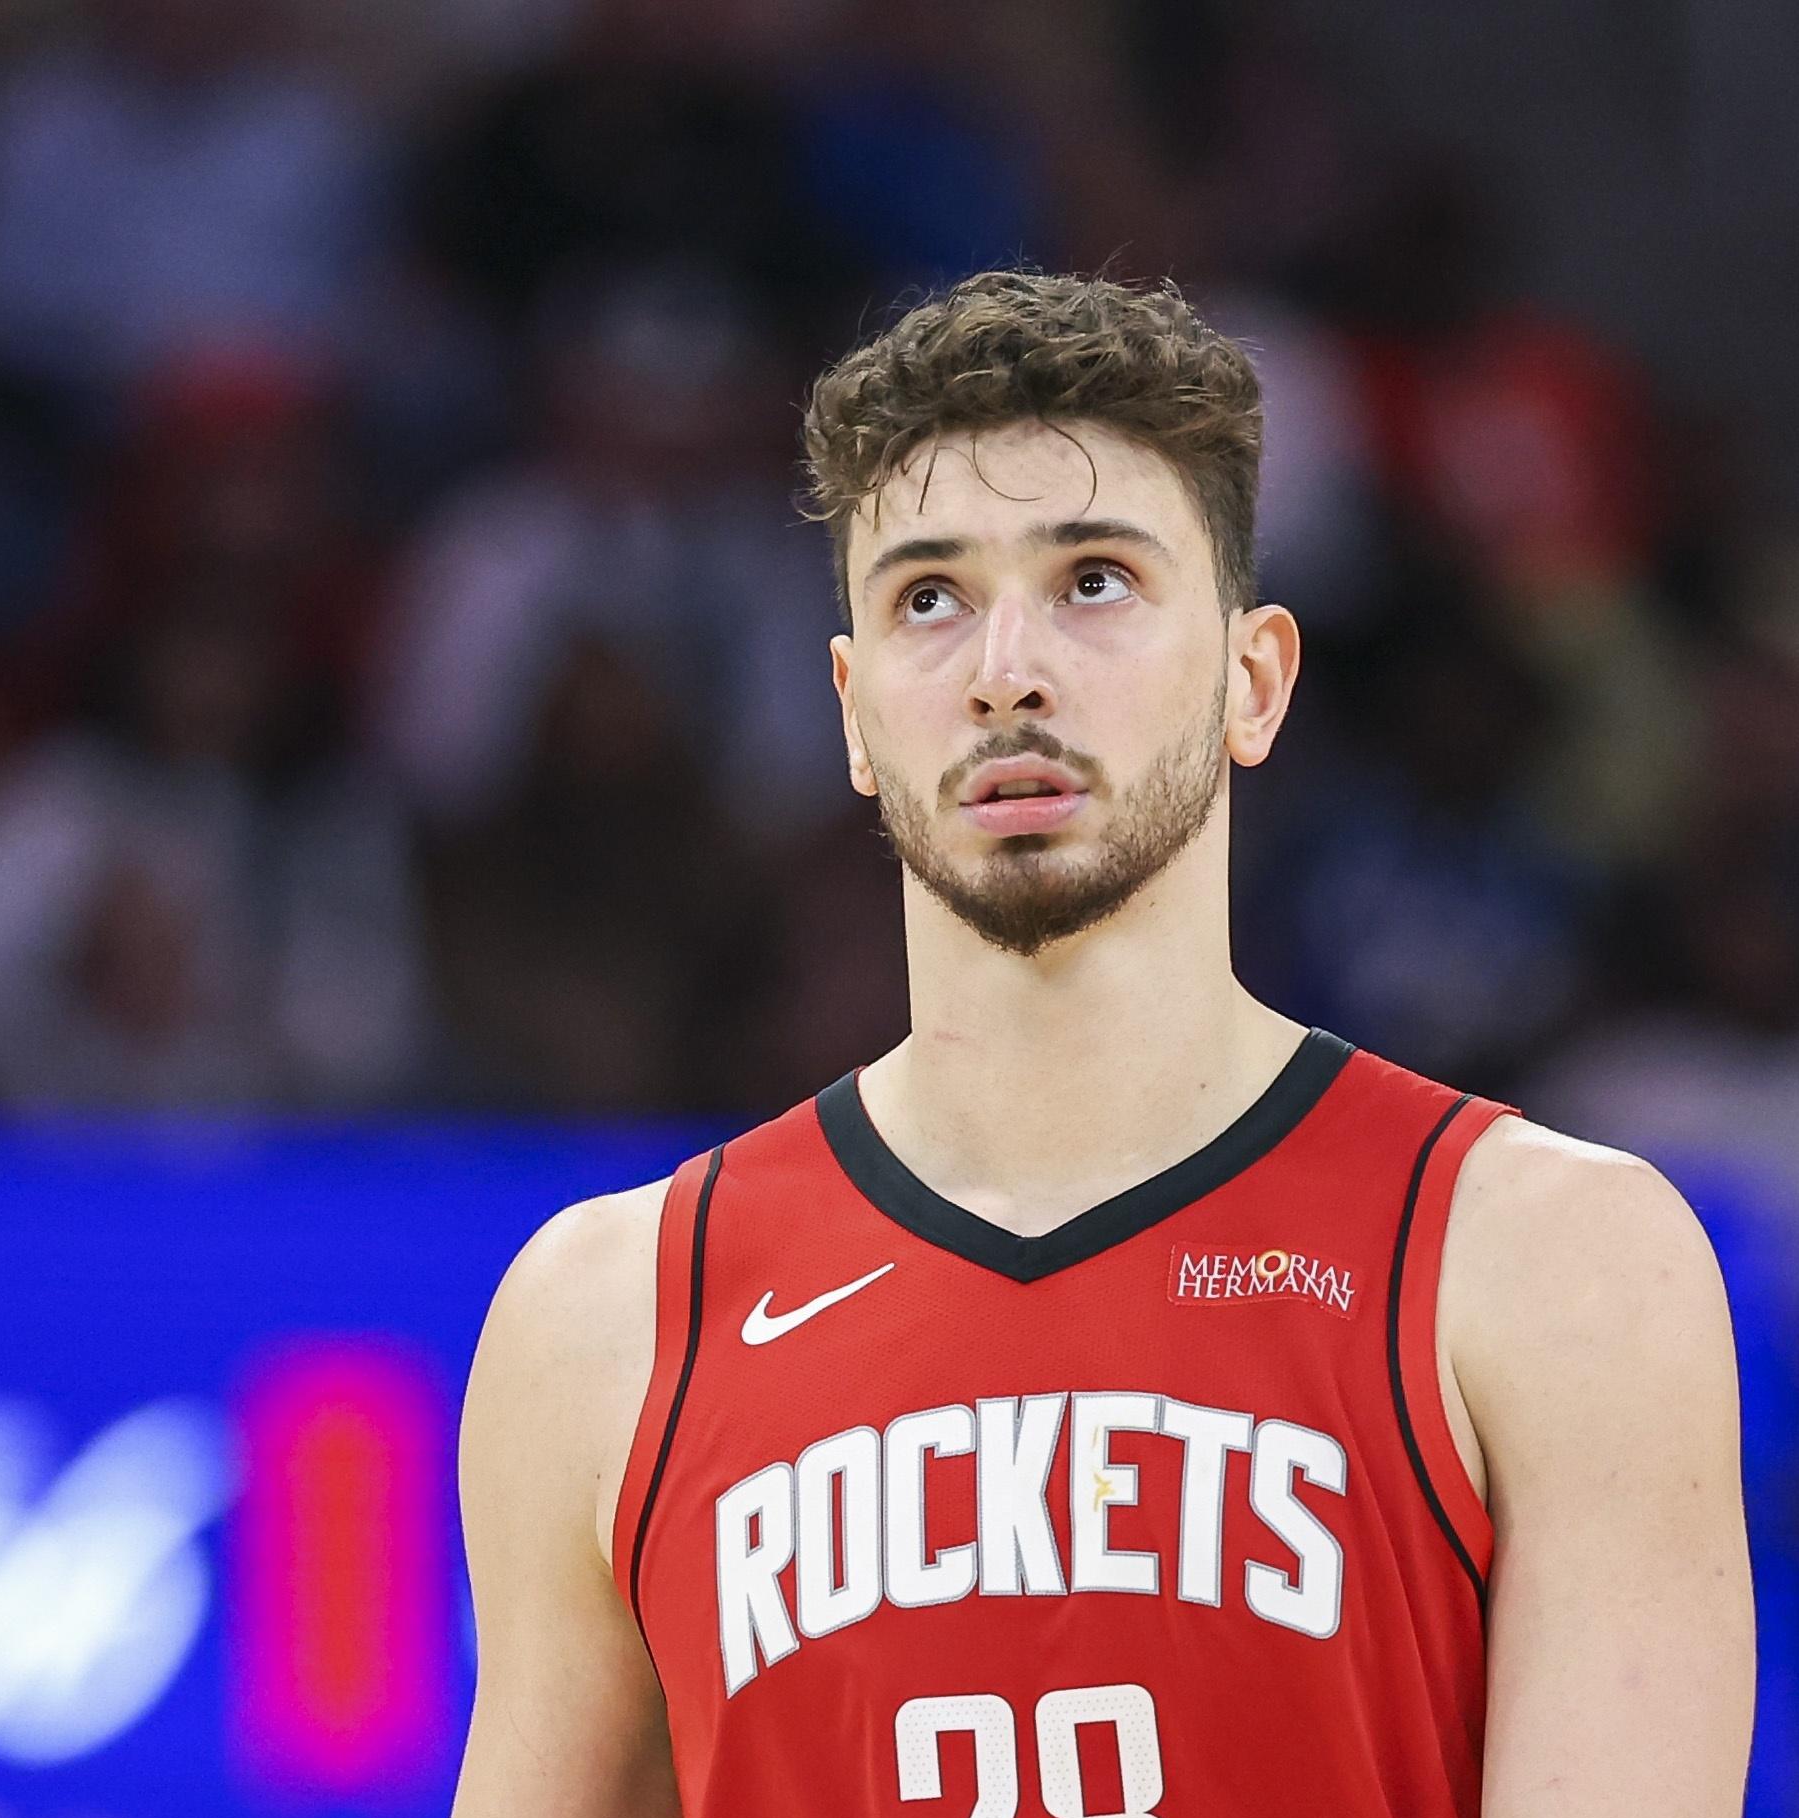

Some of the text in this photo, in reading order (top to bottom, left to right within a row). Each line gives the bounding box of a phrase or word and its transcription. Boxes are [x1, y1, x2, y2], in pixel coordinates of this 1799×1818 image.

[1176, 1271, 1354, 1312] HERMANN
[1178, 1249, 1356, 1295] MEMORIAL
[714, 1390, 1348, 1700] ROCKETS
